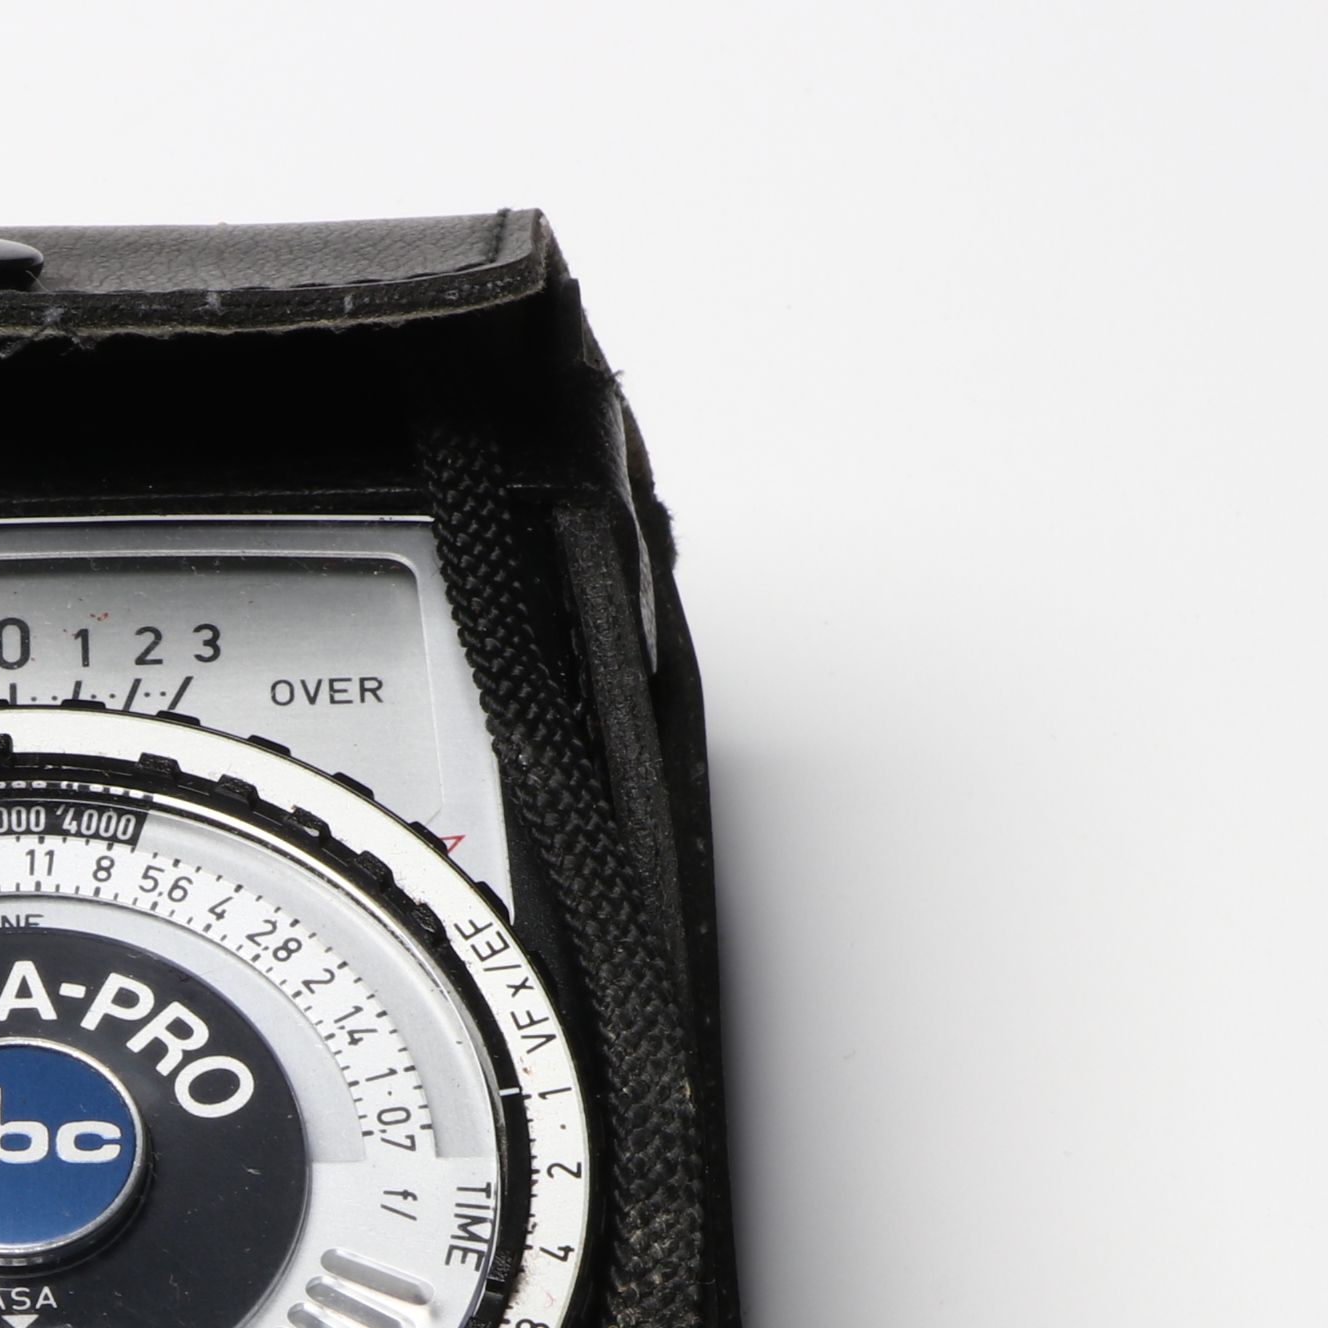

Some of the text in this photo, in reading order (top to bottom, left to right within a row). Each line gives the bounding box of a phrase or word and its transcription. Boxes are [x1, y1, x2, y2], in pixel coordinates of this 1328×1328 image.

[74, 628, 90, 667] 1
[134, 626, 163, 665] 2
[193, 623, 221, 662] 3
[270, 677, 384, 706] OVER
[25, 849, 55, 876] 11
[91, 856, 115, 882] 8
[208, 896, 234, 921] 4
[301, 968, 336, 995] 2
[547, 1161, 582, 1180] 2
[445, 1181, 492, 1273] TIME
[539, 1245, 575, 1262] 4
